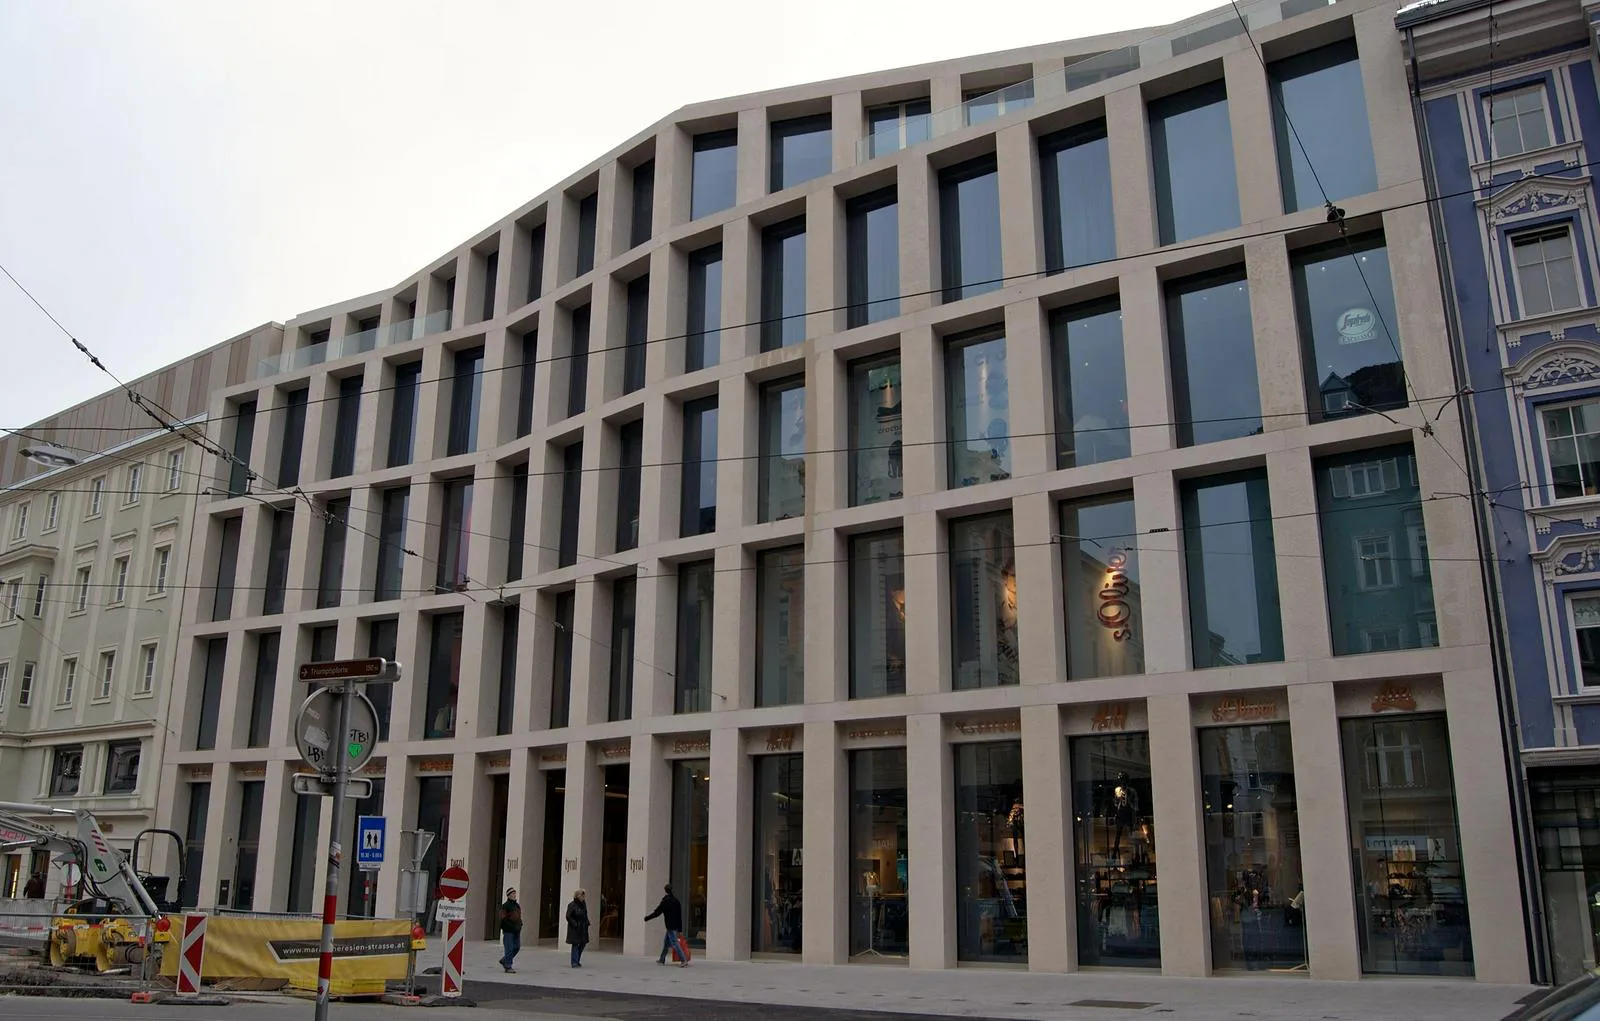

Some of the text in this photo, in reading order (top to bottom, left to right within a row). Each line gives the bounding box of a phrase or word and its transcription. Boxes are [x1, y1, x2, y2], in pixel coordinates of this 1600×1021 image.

[507, 857, 519, 872] tyrol
[565, 857, 578, 872] tyrol
[630, 857, 644, 873] tyrol
[283, 942, 405, 954] www.marheresien-strasse.at
